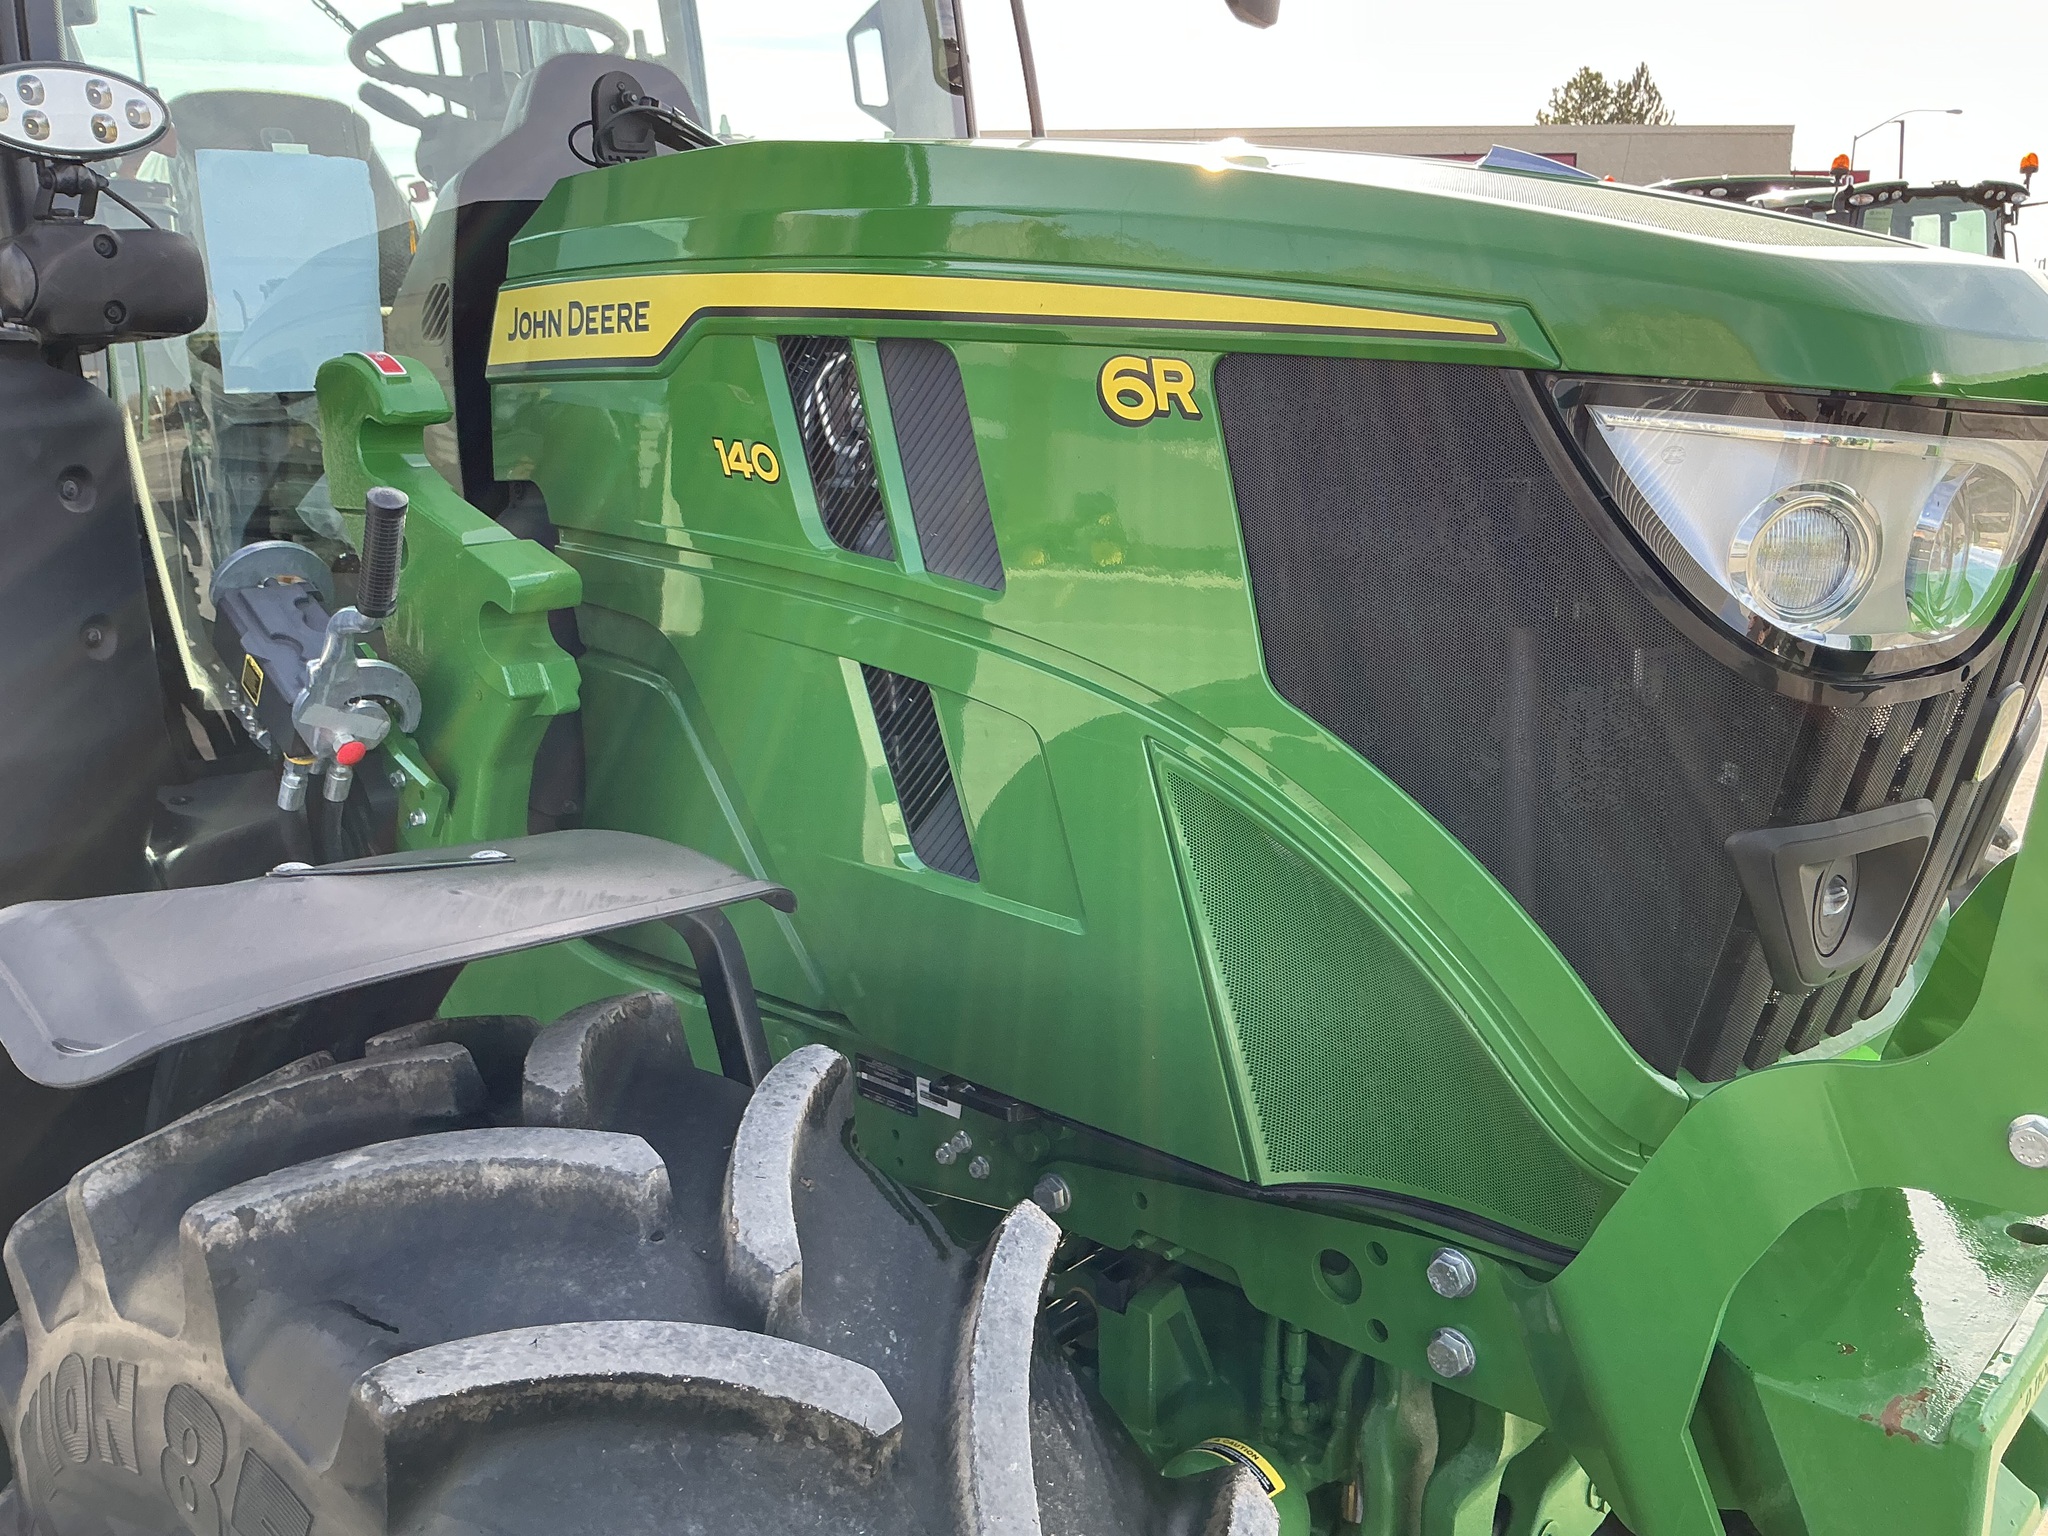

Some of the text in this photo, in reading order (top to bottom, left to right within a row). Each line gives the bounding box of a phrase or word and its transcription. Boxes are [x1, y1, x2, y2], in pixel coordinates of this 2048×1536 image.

[507, 300, 651, 342] JOHN DEERE
[1097, 354, 1203, 427] 6R
[712, 436, 780, 484] 140
[1222, 1439, 1260, 1461] CAUTION
